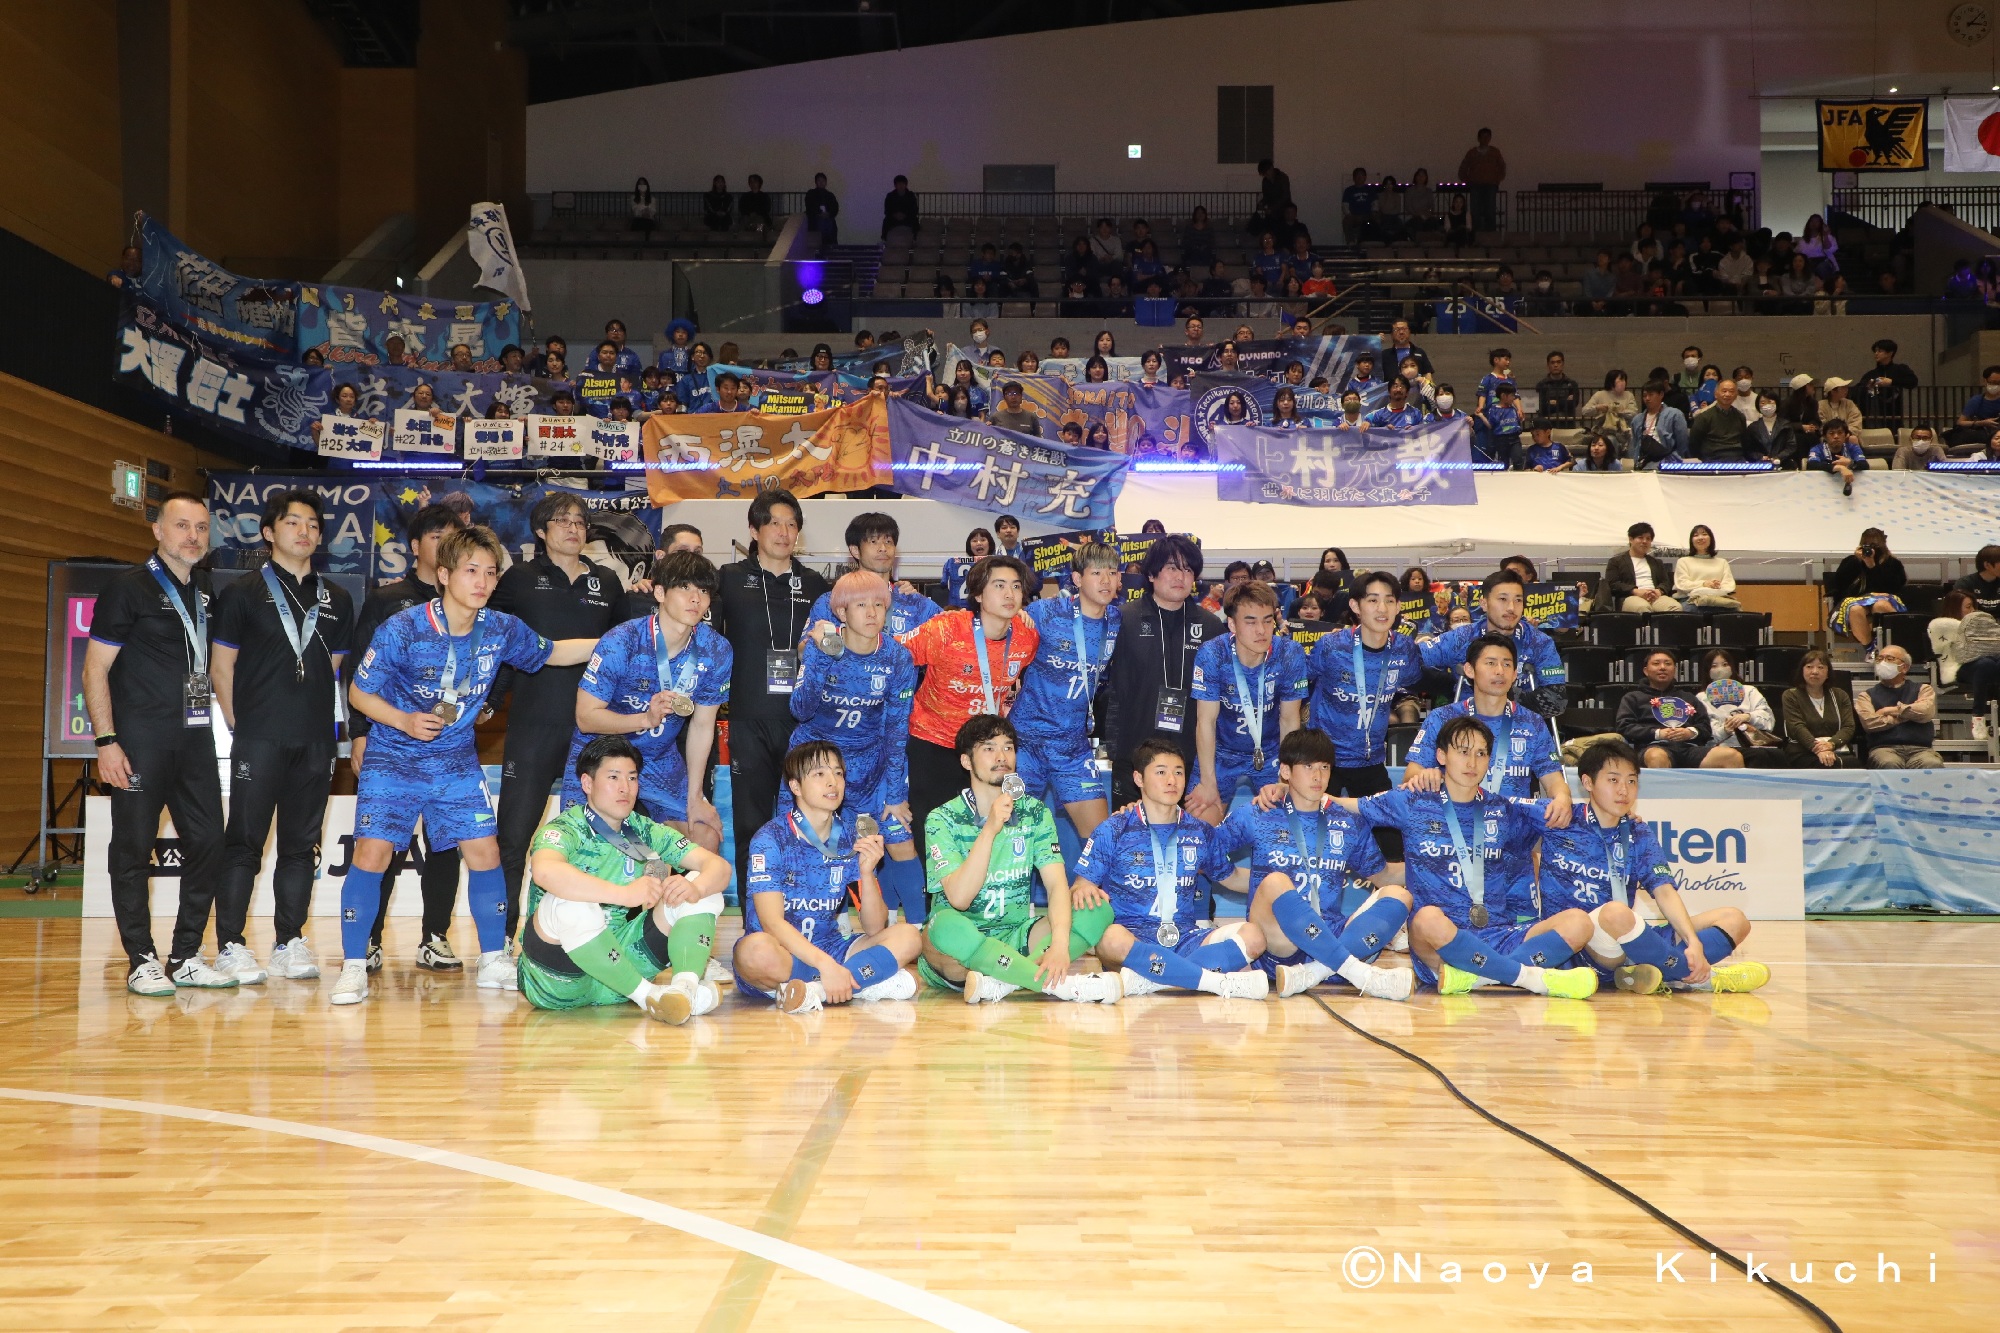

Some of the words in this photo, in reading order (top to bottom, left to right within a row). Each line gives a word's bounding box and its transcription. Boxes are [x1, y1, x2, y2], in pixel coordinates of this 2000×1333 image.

[1824, 109, 1863, 128] JFA
[1444, 296, 1467, 314] 25
[401, 351, 503, 373] Minaoto
[1181, 356, 1203, 365] NEO
[1238, 351, 1281, 361] DYNAMO
[584, 378, 616, 389] Atsuya
[581, 388, 617, 398] Uemura
[766, 394, 805, 405] Mitsuru
[760, 404, 808, 414] Nakamura
[320, 438, 343, 452] #25
[395, 434, 416, 445] #22
[540, 440, 565, 452] #24
[946, 428, 1067, 467] 立川の蒼き猛獣
[906, 442, 1097, 519] 中村充
[213, 480, 370, 506] NAGMO
[1262, 484, 1431, 502] 世界に羽ばたく貴公子
[1103, 532, 1115, 543] 21
[1033, 544, 1068, 560] Shogo
[1033, 553, 1073, 572] Hiyama
[1126, 587, 1146, 600] Tet
[1525, 591, 1565, 607] Shuya
[279, 603, 290, 616] JFA
[307, 609, 316, 621] JFA
[434, 602, 443, 616] JFA
[478, 609, 486, 622] JFA
[1523, 602, 1568, 620] Nagata
[182, 611, 192, 625] JFA
[973, 617, 981, 631] JFA
[1292, 632, 1327, 644] Mitsu
[446, 660, 455, 675] JFA
[677, 678, 687, 691] JFA
[1066, 675, 1086, 700] 17
[75, 693, 83, 711] 1
[831, 695, 885, 707] TACHIH
[1243, 694, 1251, 707] JFA
[71, 716, 84, 734] 0
[834, 708, 862, 729] 79
[1510, 728, 1533, 737] ノベる。
[1496, 758, 1504, 772] JFA
[1439, 790, 1449, 804] JFA
[1285, 801, 1294, 815] JFA
[792, 809, 804, 824] JFA
[1327, 819, 1351, 828] ノベる。
[328, 834, 425, 877] JA
[1457, 846, 1466, 860] JFA
[1166, 861, 1174, 875] JFA
[1572, 879, 1599, 904] 25
[790, 896, 843, 911] TACHIH
[983, 889, 1005, 919] 21
